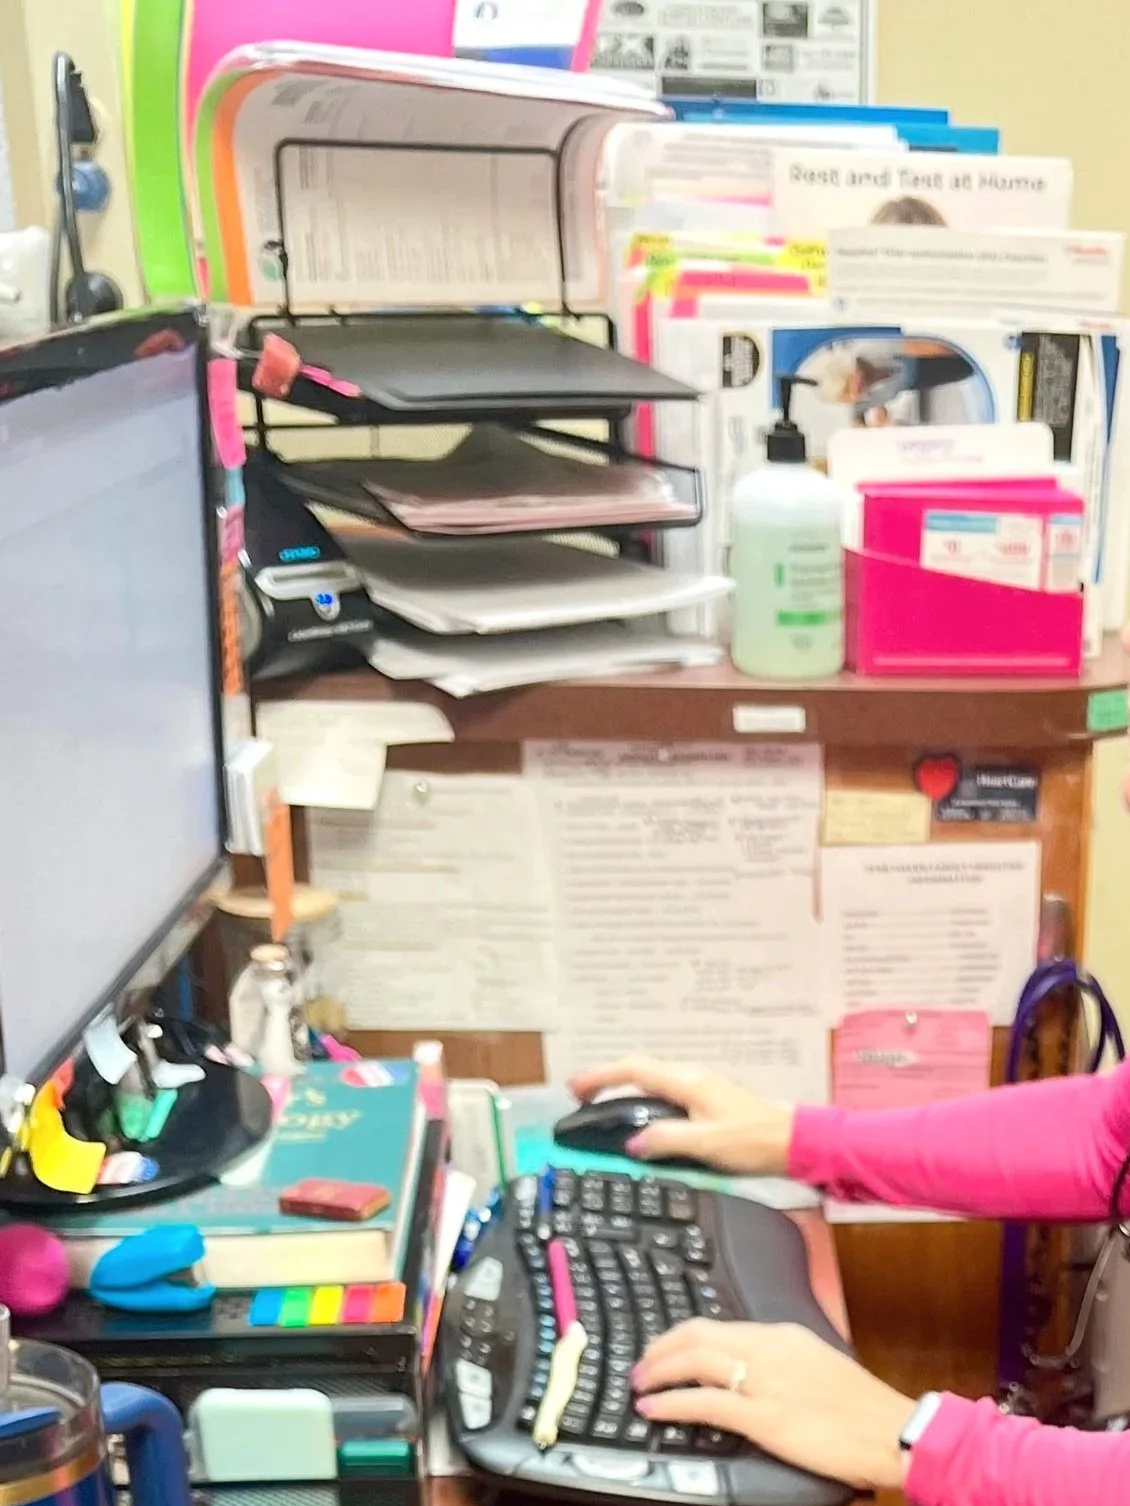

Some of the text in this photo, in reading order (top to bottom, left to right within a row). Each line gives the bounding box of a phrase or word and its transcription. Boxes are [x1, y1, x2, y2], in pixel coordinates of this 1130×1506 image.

[789, 165, 1047, 191] Rest and Test at Home
